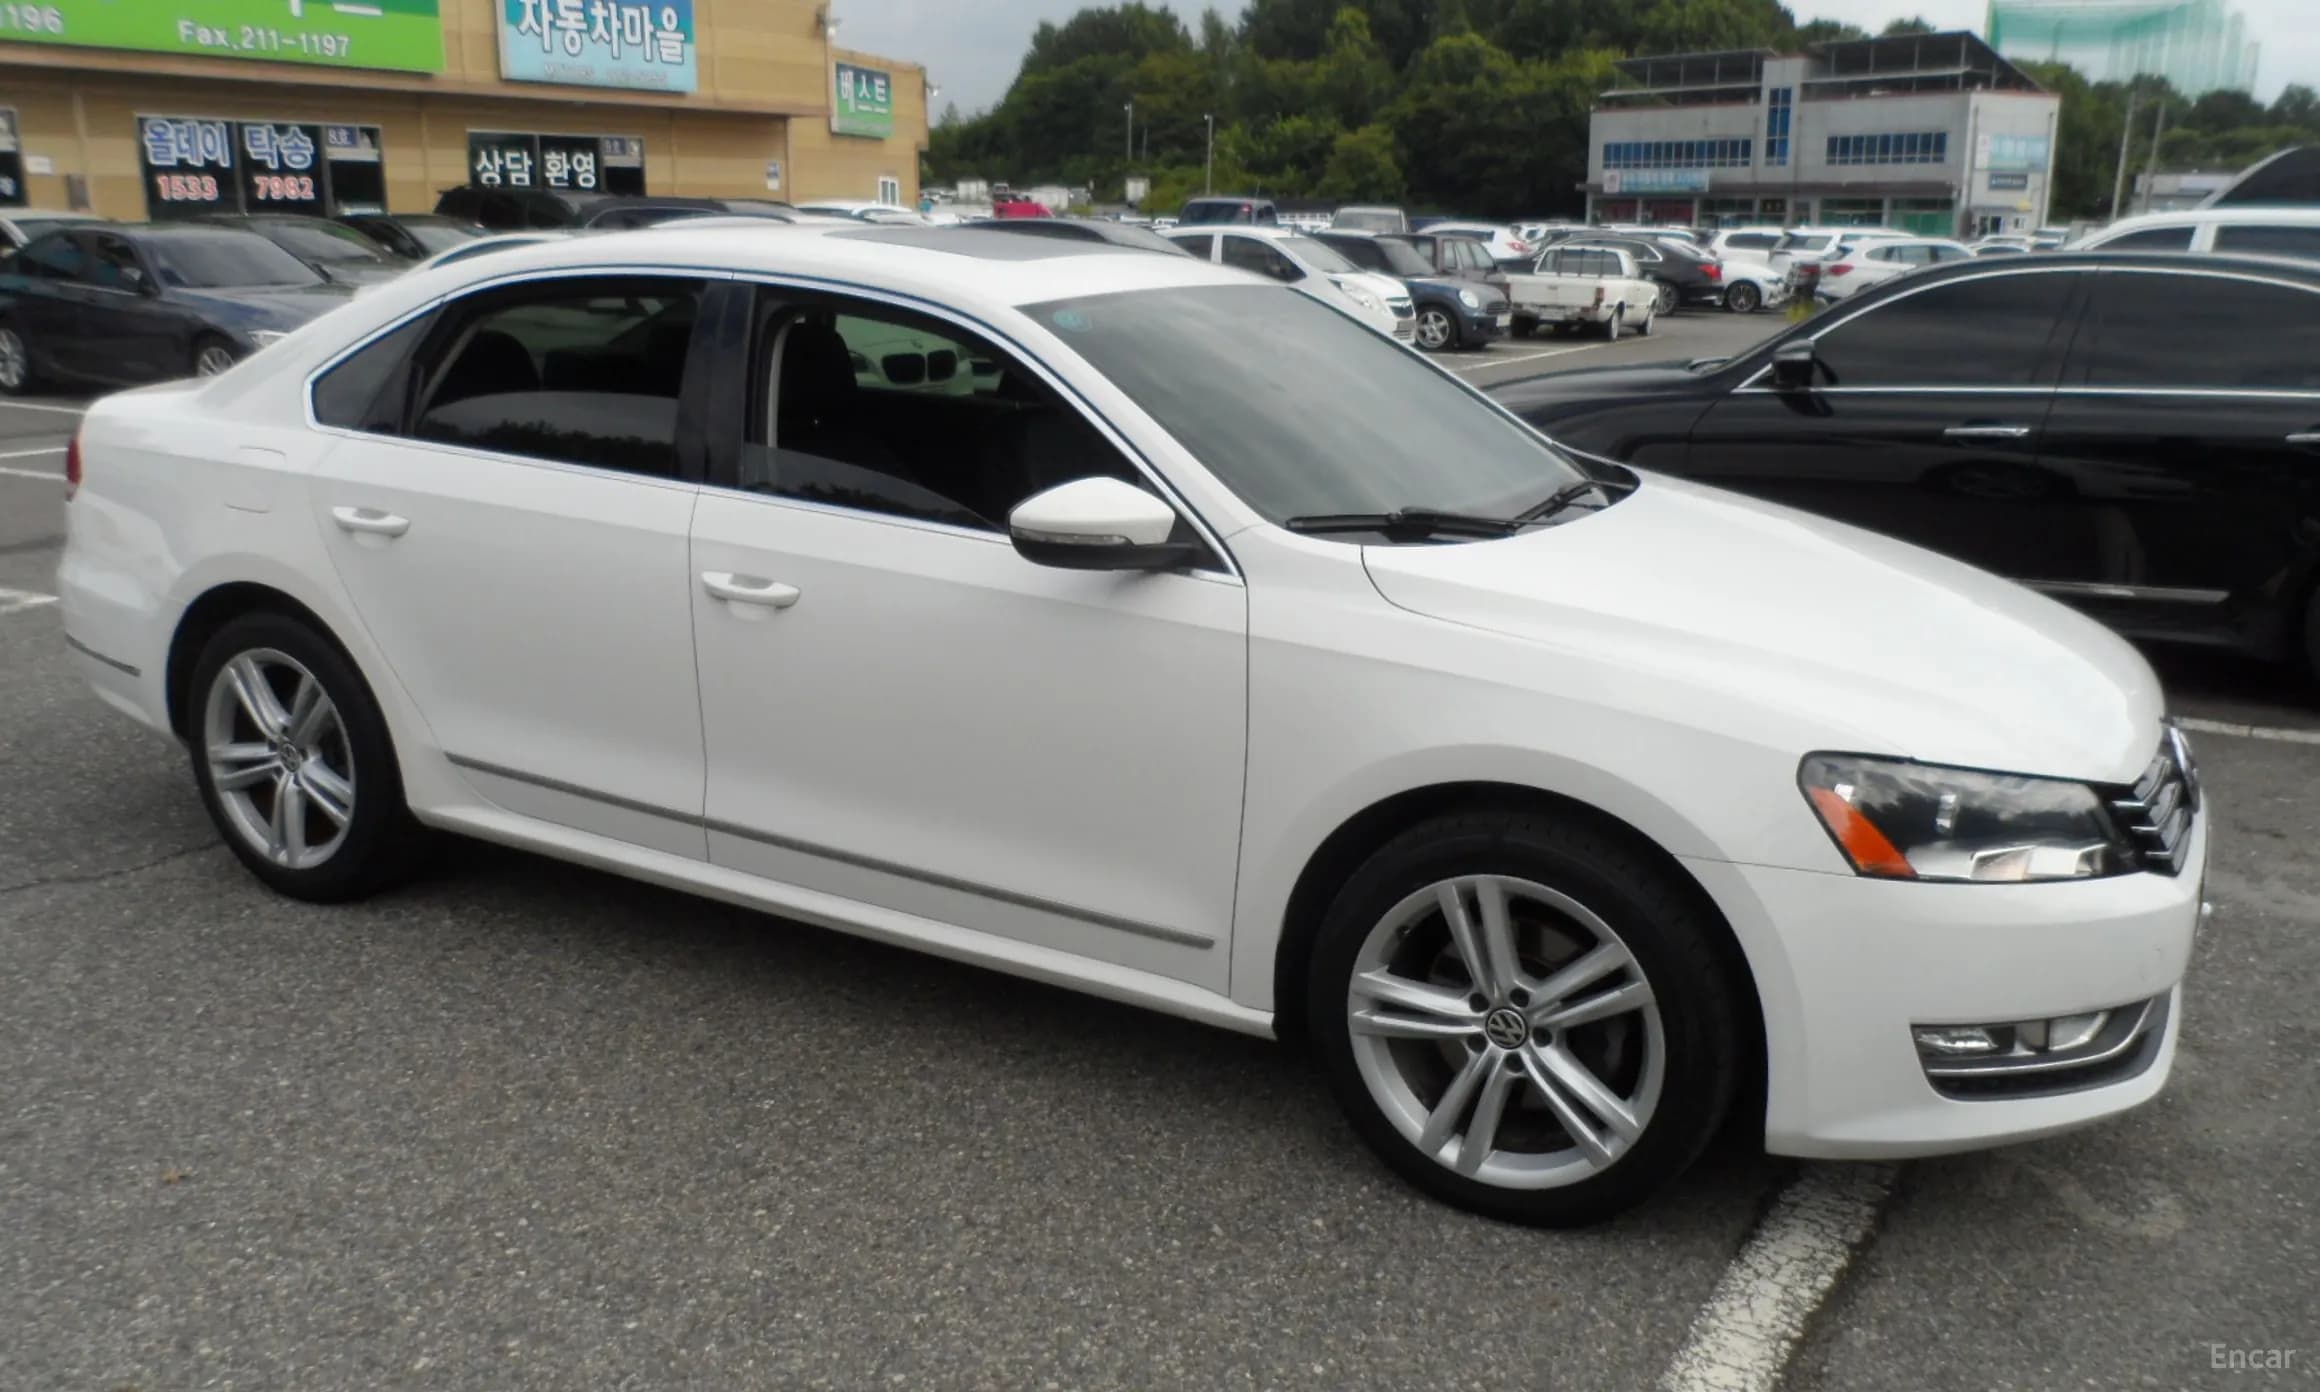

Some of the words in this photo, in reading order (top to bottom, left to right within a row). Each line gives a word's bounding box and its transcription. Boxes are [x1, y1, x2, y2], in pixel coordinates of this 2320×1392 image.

[177, 19, 350, 57] Fax.211-1197
[519, 0, 685, 64] 자동차마을
[840, 70, 888, 114] 베스트
[144, 119, 231, 168] 올데이
[244, 124, 315, 170] 탁송
[476, 150, 533, 186] 상담
[544, 151, 596, 188] 환영
